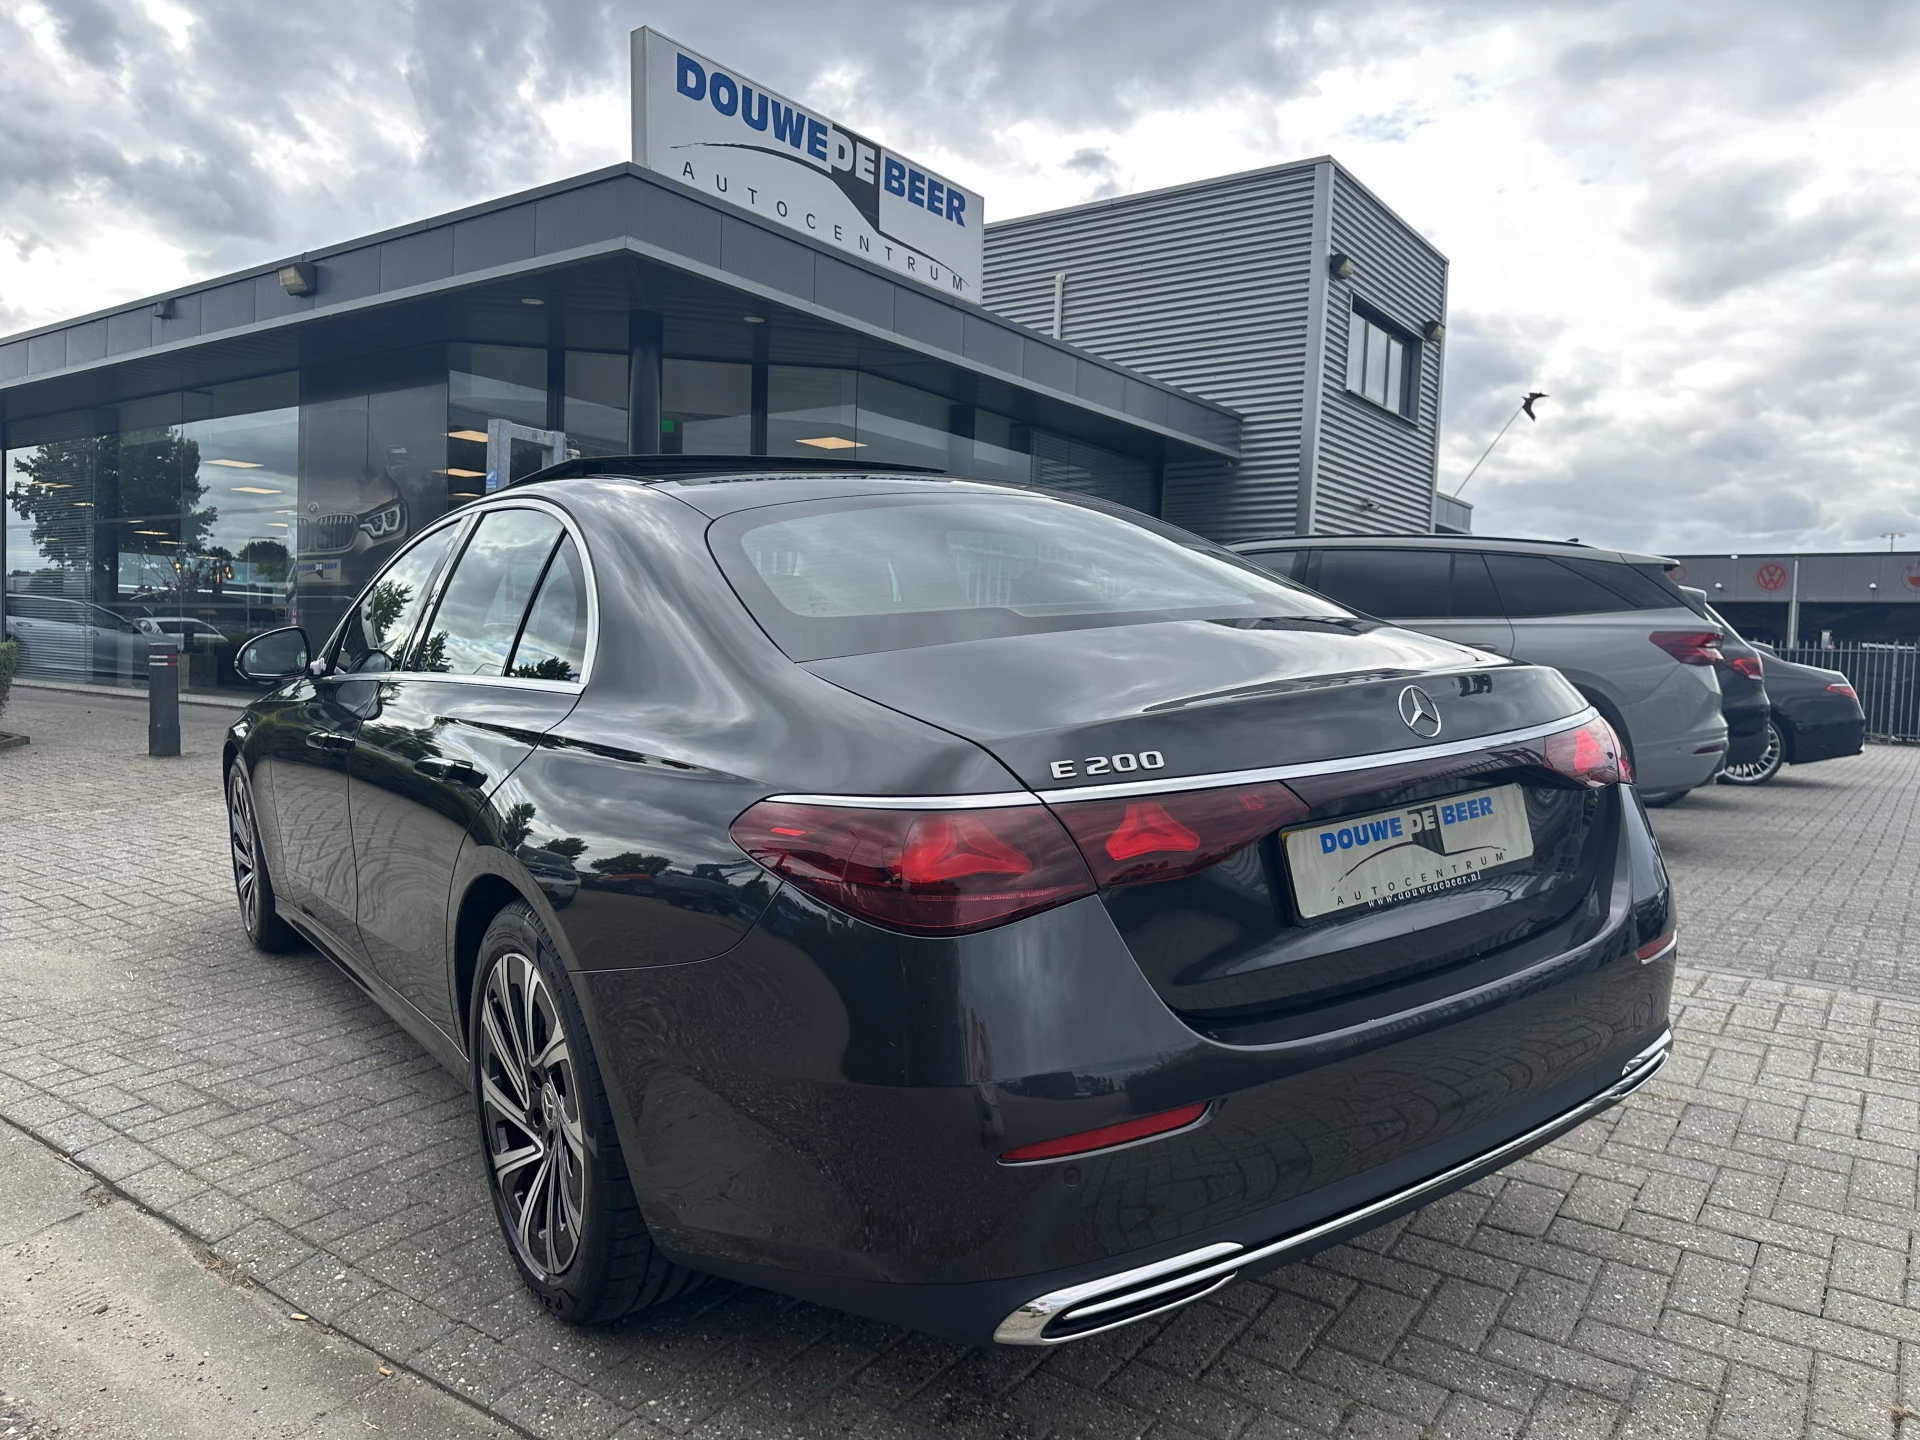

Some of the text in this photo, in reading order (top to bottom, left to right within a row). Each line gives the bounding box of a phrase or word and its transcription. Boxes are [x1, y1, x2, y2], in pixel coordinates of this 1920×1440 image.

[676, 52, 966, 228] DOUWE DE BEER
[682, 161, 963, 292] AUTOCENTRUM
[1050, 750, 1165, 780] E 200
[1320, 796, 1494, 854] DOUWE DE BEER
[1337, 852, 1505, 906] AUTOCENTRUM
